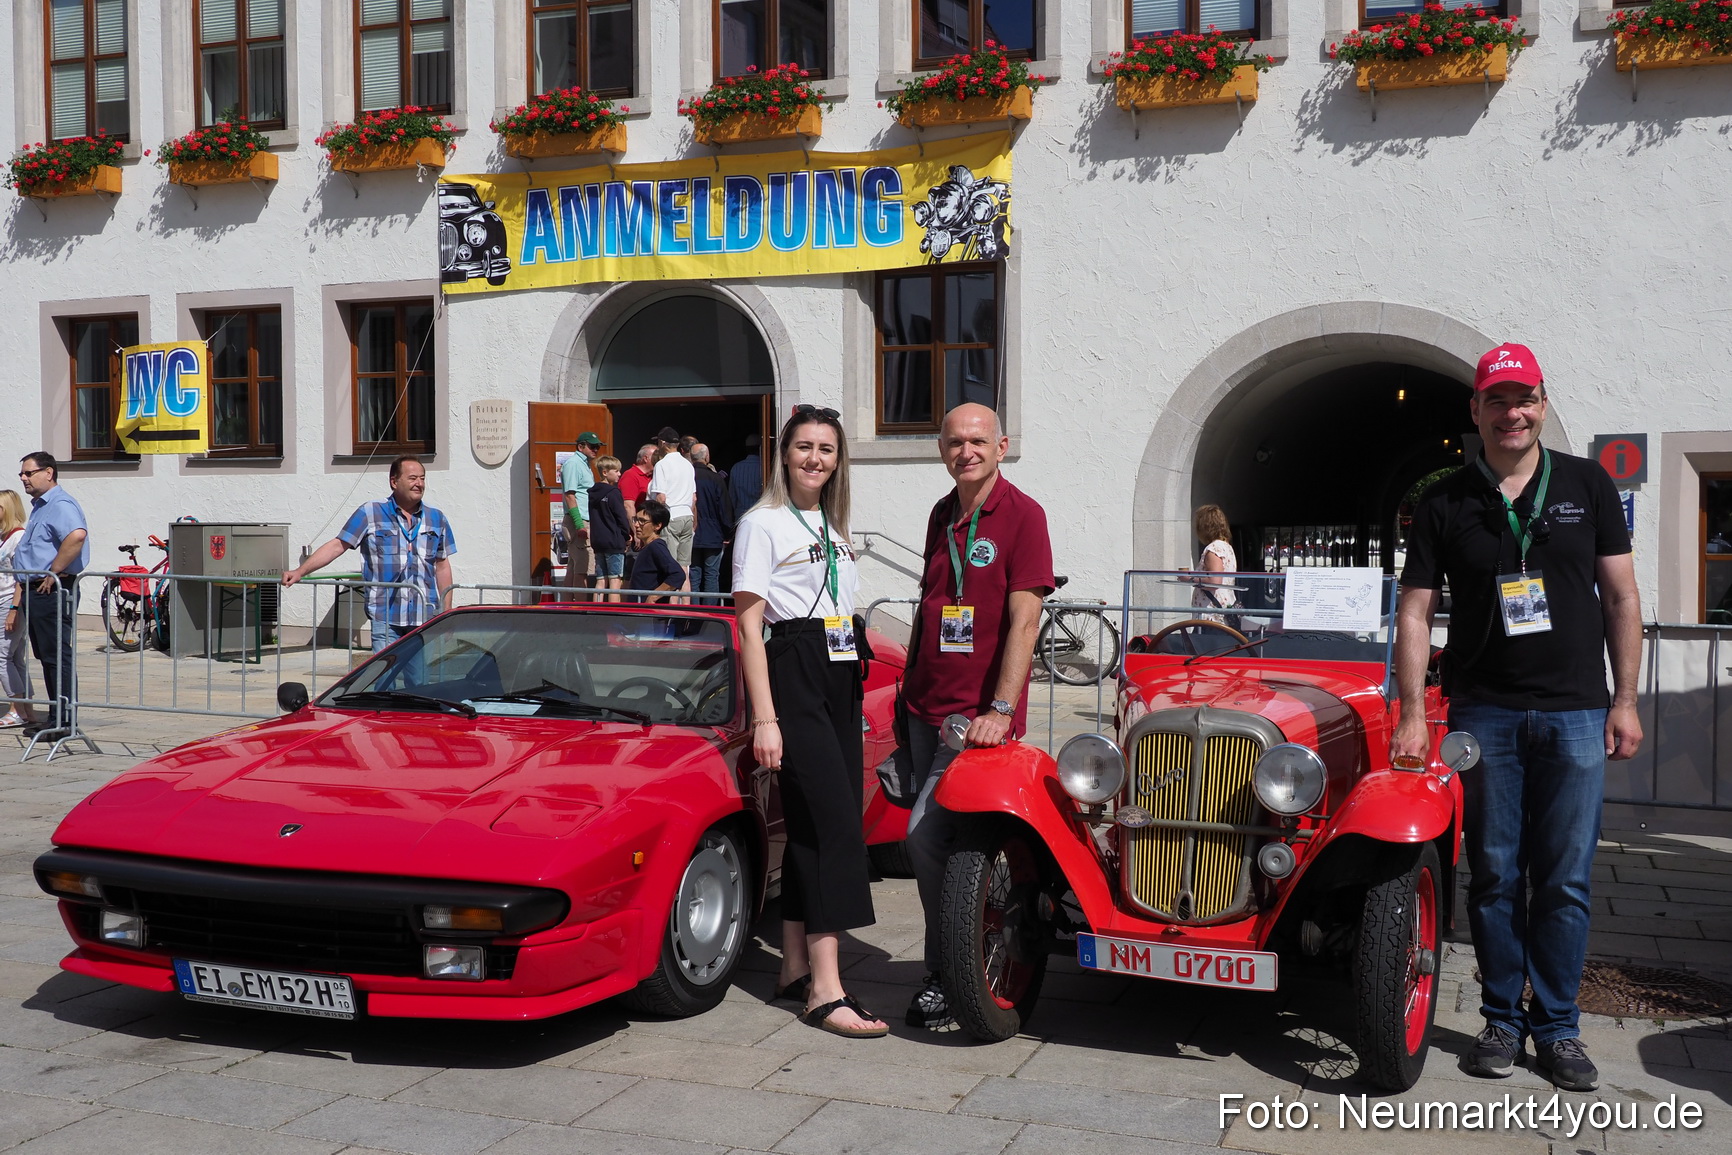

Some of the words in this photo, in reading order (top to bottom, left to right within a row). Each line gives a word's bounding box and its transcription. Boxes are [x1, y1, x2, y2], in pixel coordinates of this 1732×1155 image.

[519, 165, 905, 266] ANMELDUNG
[1488, 360, 1523, 374] DEKRA
[126, 347, 200, 420] WC
[232, 568, 279, 578] RATHAUSPLATZ
[1137, 767, 1185, 797] Aero
[1084, 954, 1091, 962] D
[1110, 942, 1151, 973] NM
[1174, 950, 1256, 985] 0700
[183, 979, 190, 987] D
[193, 966, 228, 995] EI
[333, 982, 346, 991] 05
[338, 1000, 350, 1009] 10
